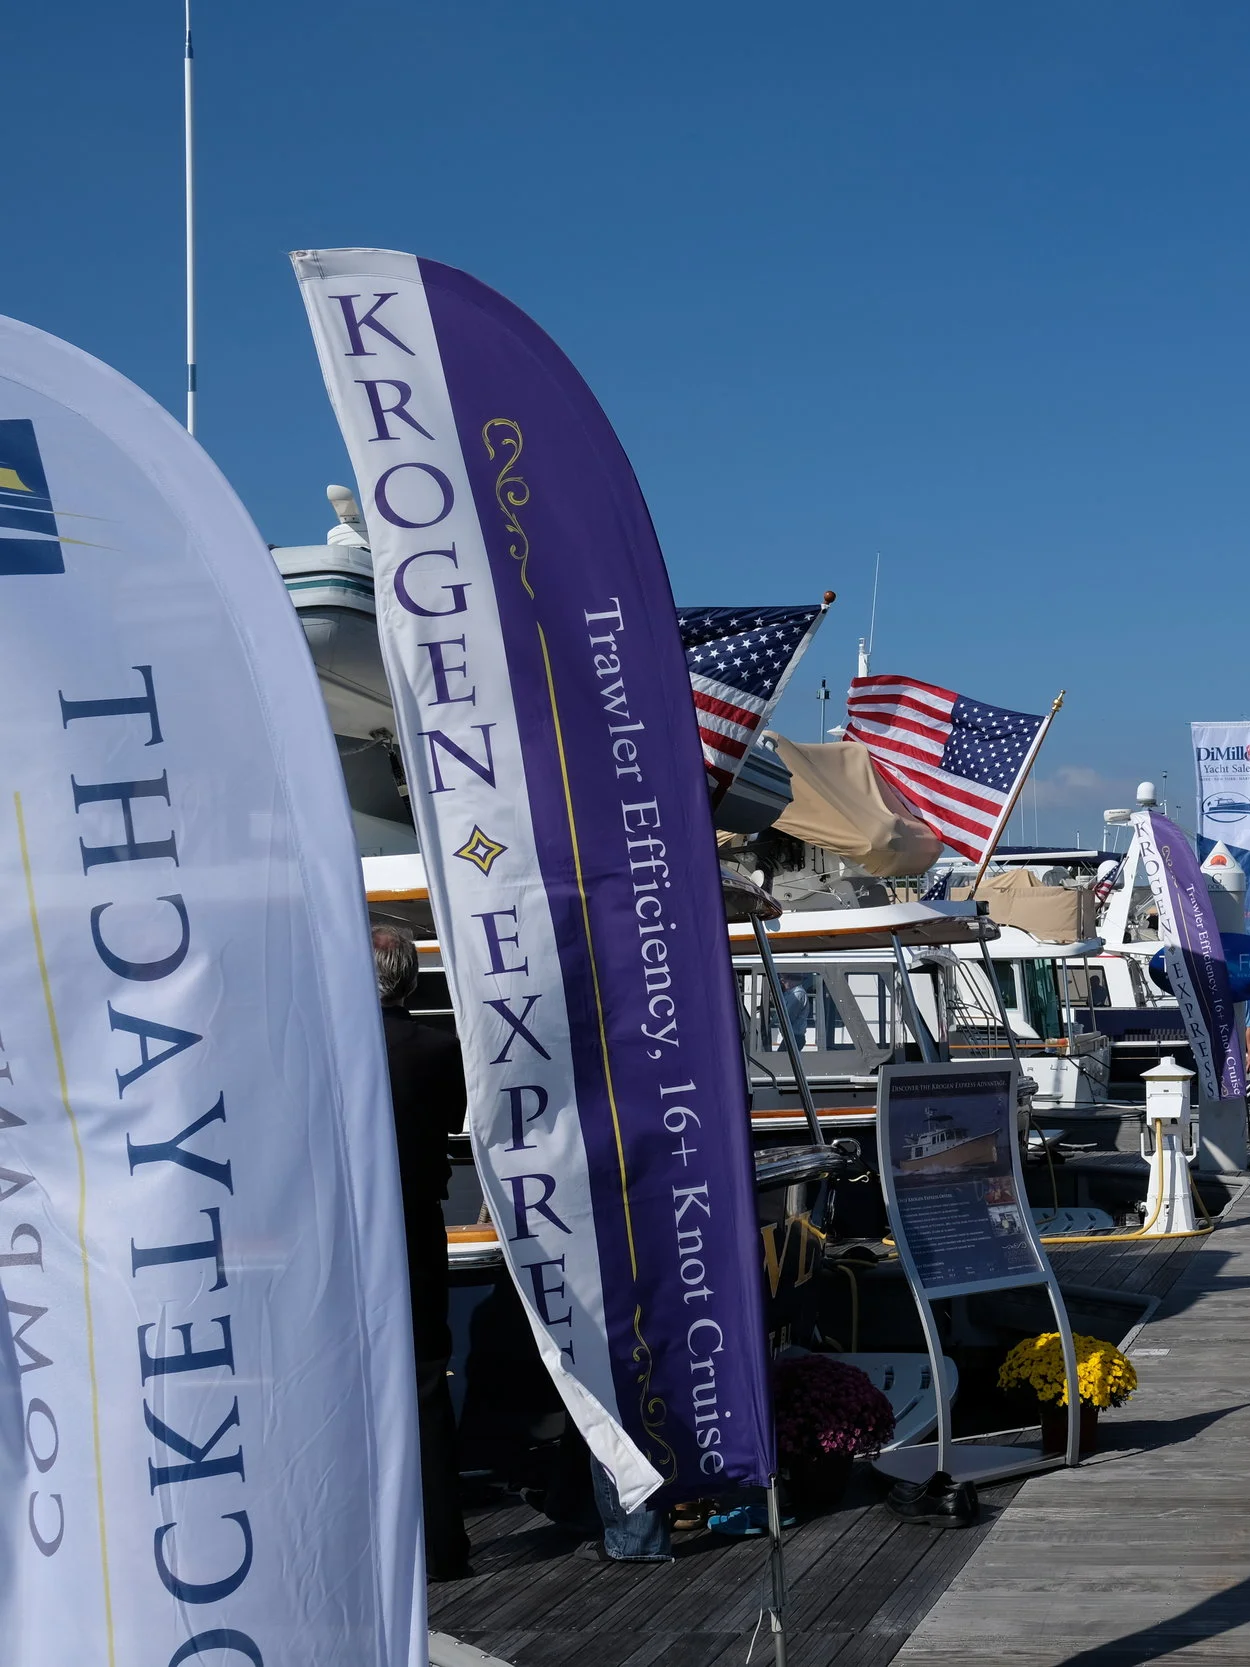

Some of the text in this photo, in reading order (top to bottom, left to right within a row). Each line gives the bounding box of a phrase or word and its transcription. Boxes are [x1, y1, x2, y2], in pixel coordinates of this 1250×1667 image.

[1203, 764, 1229, 775] Yacht
[327, 291, 575, 1365] KROGEN EXPRE
[1185, 883, 1206, 931] Trawler
[1134, 820, 1215, 1099] KROGEN EXPRESS
[582, 596, 726, 1477] Trawler Efficiency, 16+ Knot Cruise
[1218, 1023, 1232, 1052] Knot
[1224, 1051, 1242, 1096] Cruise
